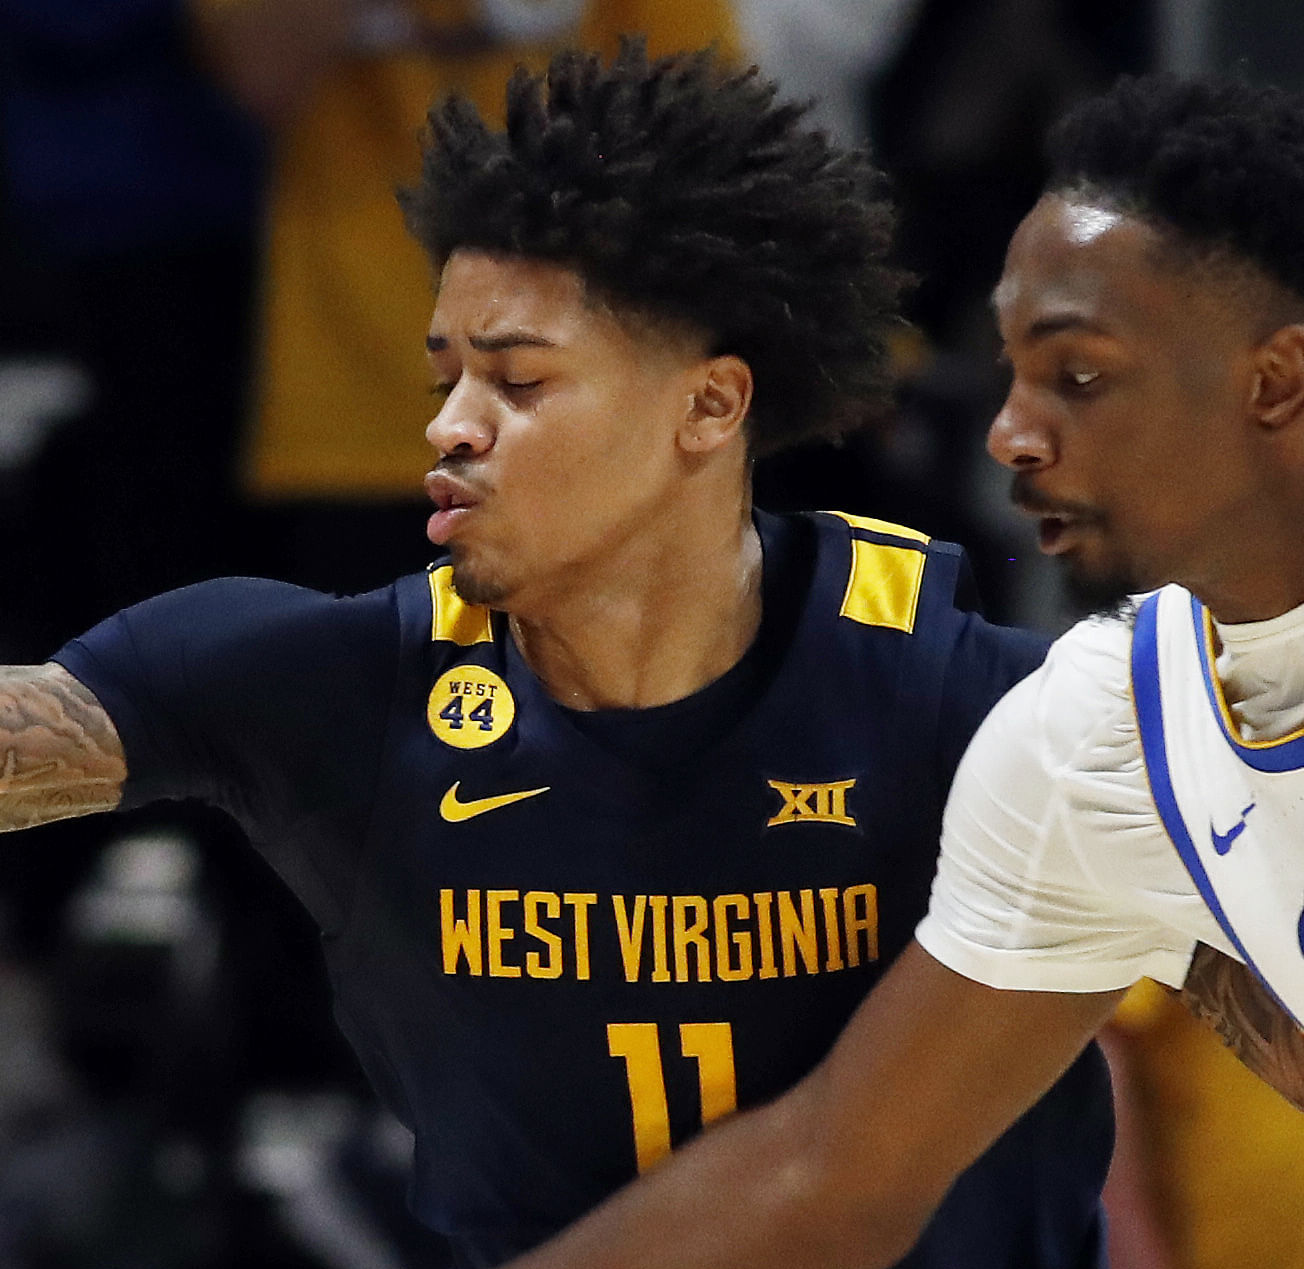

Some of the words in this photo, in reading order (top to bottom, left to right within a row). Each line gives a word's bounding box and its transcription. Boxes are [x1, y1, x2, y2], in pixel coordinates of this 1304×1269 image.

[439, 695, 494, 731] 44
[449, 681, 498, 697] WEST
[767, 778, 857, 827] XII
[439, 888, 598, 981] WEST
[611, 883, 880, 983] VIRGINIA
[606, 1021, 738, 1175] 11
